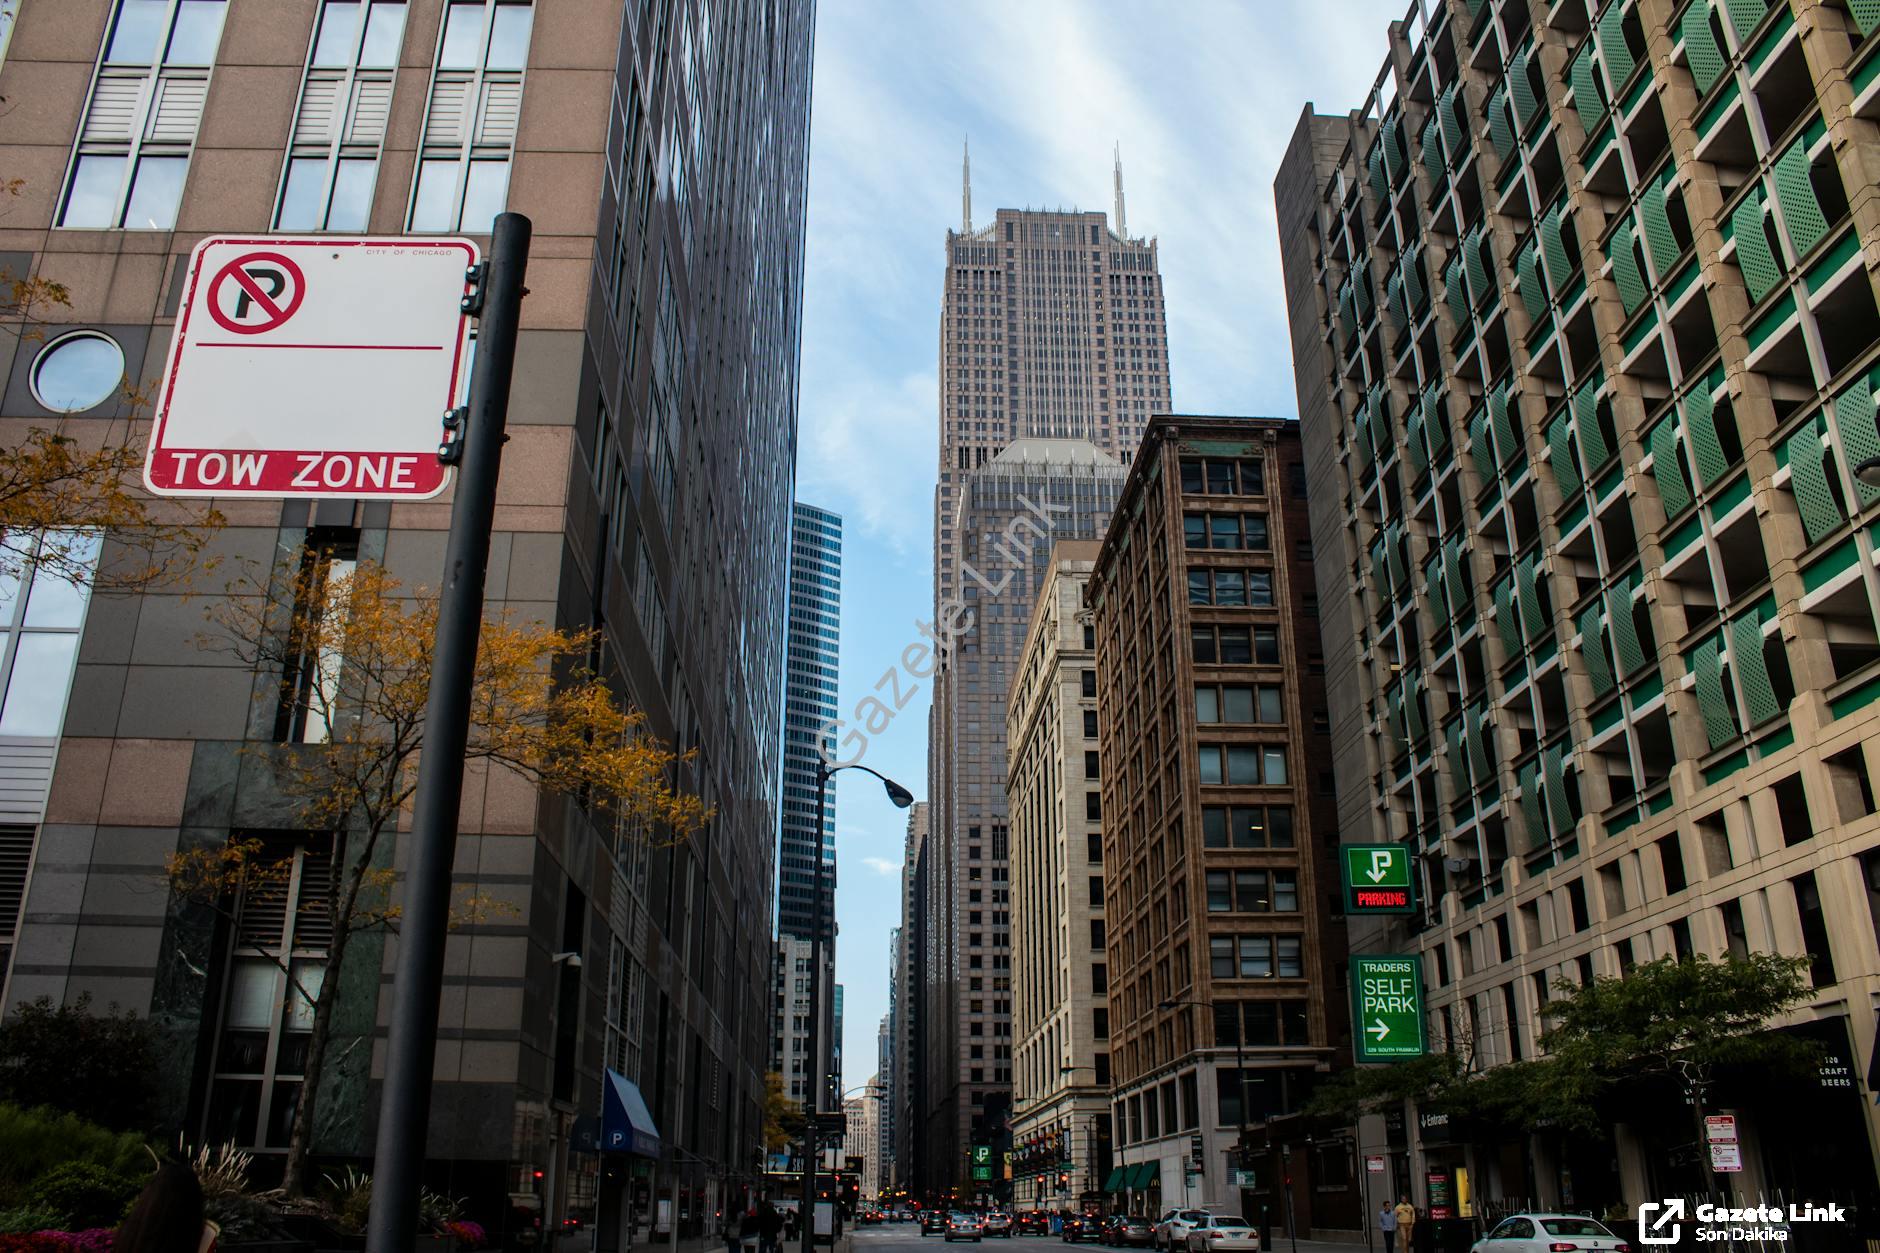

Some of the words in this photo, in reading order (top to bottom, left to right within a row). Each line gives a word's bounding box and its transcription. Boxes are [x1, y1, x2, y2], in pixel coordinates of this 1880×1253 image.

[170, 452, 268, 487] TOW
[290, 454, 418, 489] ZONE
[1357, 892, 1406, 906] PARKING
[1363, 963, 1411, 973] TRADERS
[1363, 978, 1412, 996] SELF
[1364, 997, 1416, 1013] PARK
[1819, 1067, 1848, 1076] CRAFT
[1821, 1078, 1851, 1087] BEERS
[1426, 1113, 1449, 1127] Entranc
[612, 1133, 623, 1145] P
